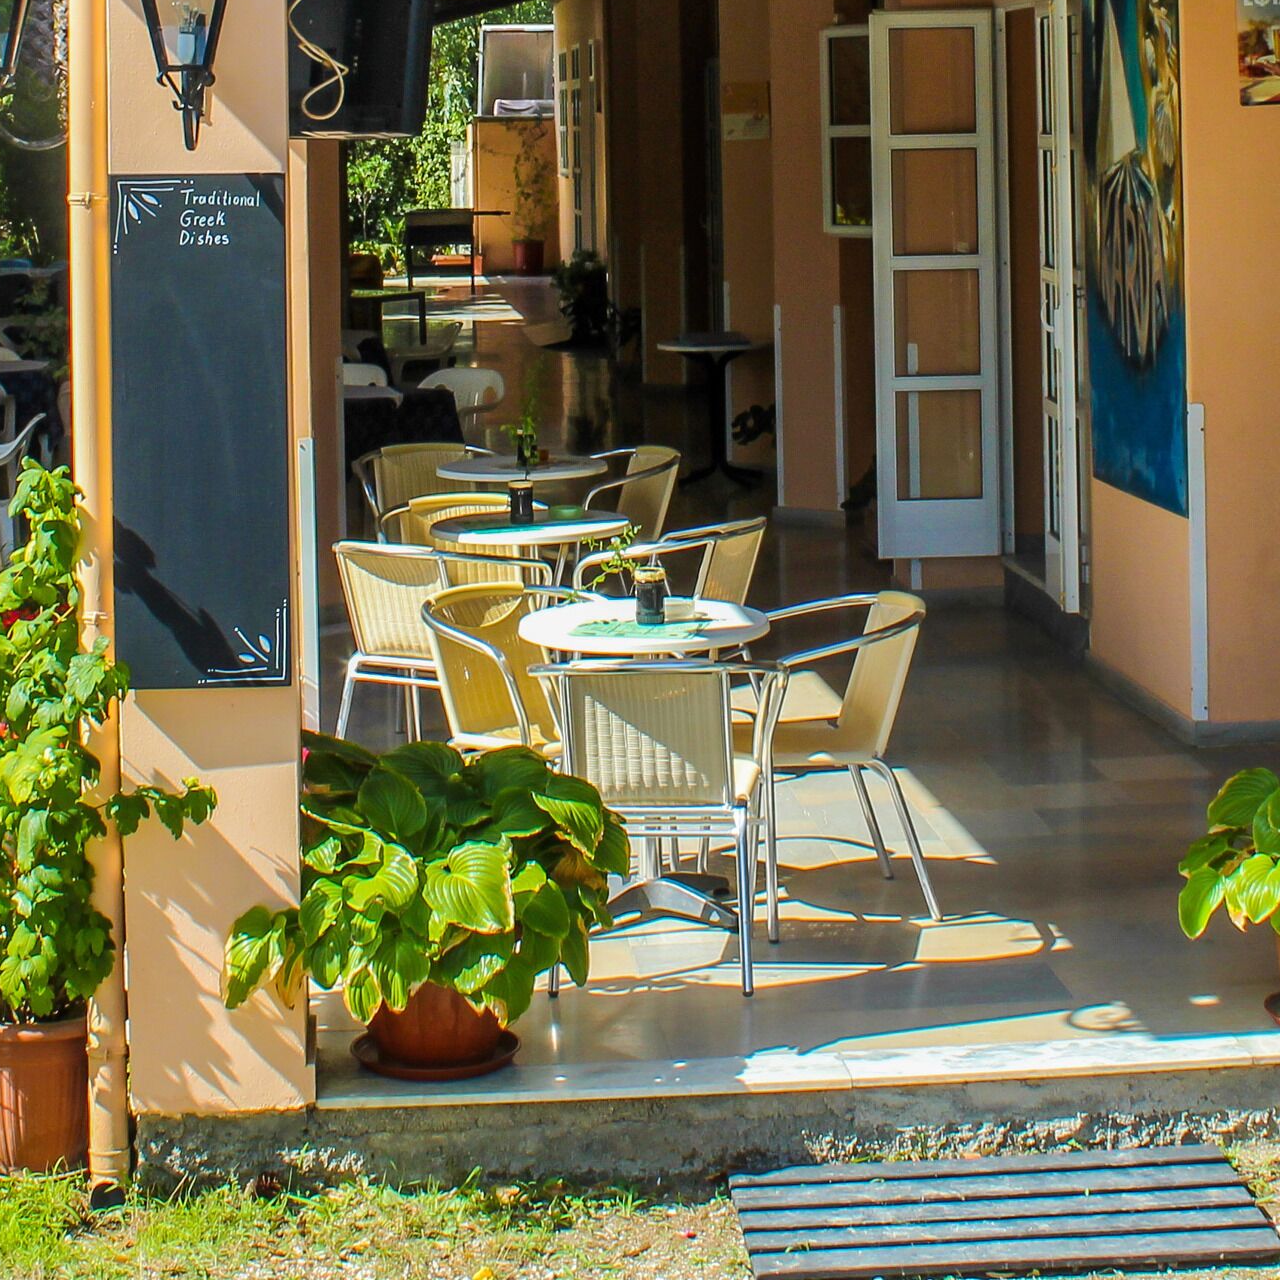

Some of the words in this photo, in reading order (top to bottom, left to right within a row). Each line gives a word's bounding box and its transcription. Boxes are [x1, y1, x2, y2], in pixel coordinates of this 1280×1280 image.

[180, 188, 261, 208] Traditional
[180, 210, 226, 228] Greek
[179, 229, 230, 246] Dishes
